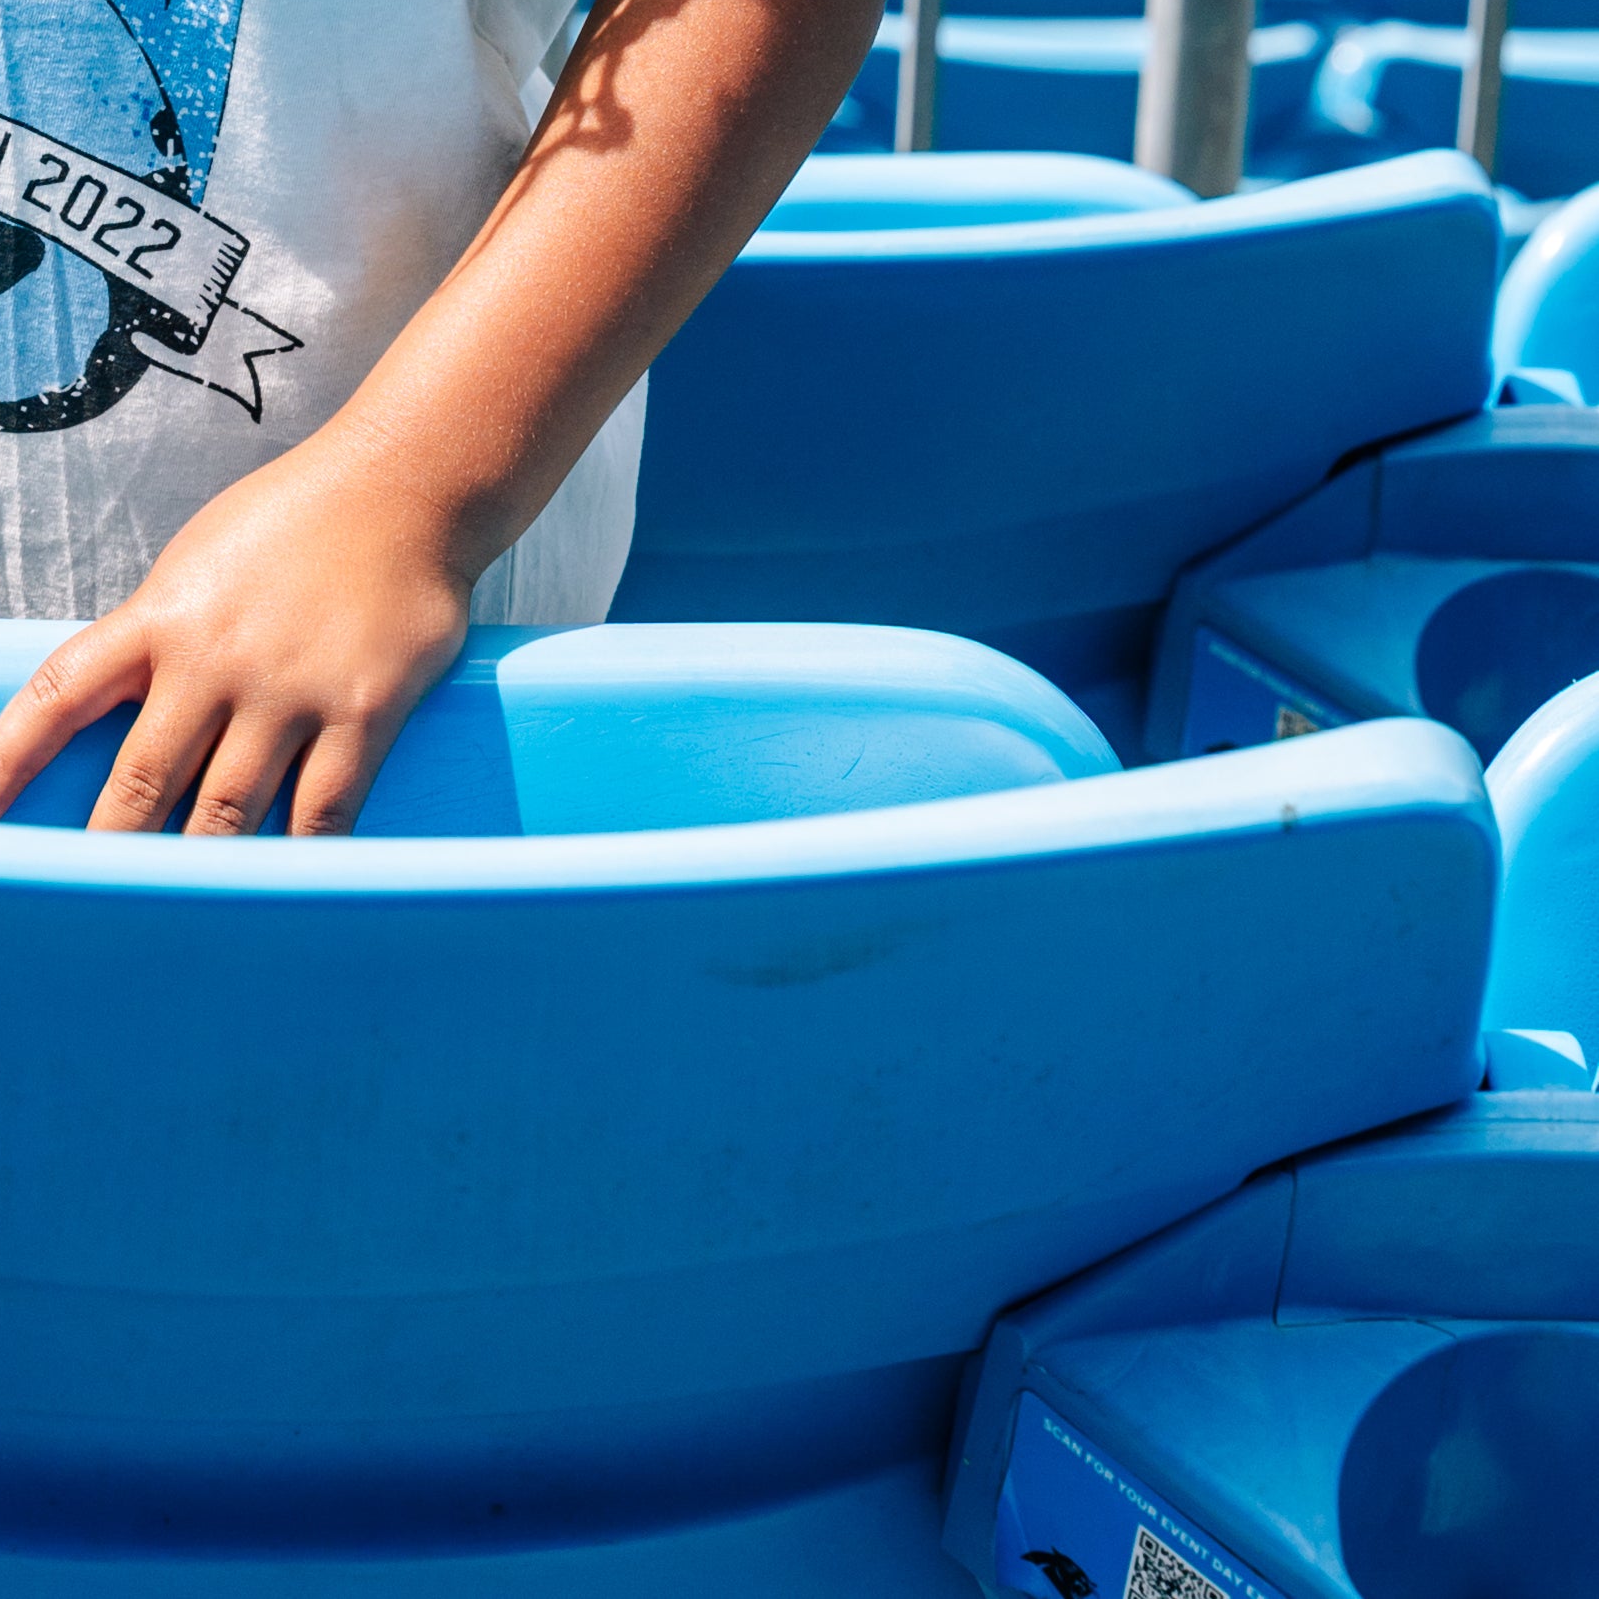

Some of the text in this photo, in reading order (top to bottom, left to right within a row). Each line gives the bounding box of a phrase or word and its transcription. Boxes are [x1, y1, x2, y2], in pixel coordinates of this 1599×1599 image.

[21, 152, 183, 281] 2022
[1043, 1417, 1244, 1588] SCAN FOR YOUR EVENT DAY
